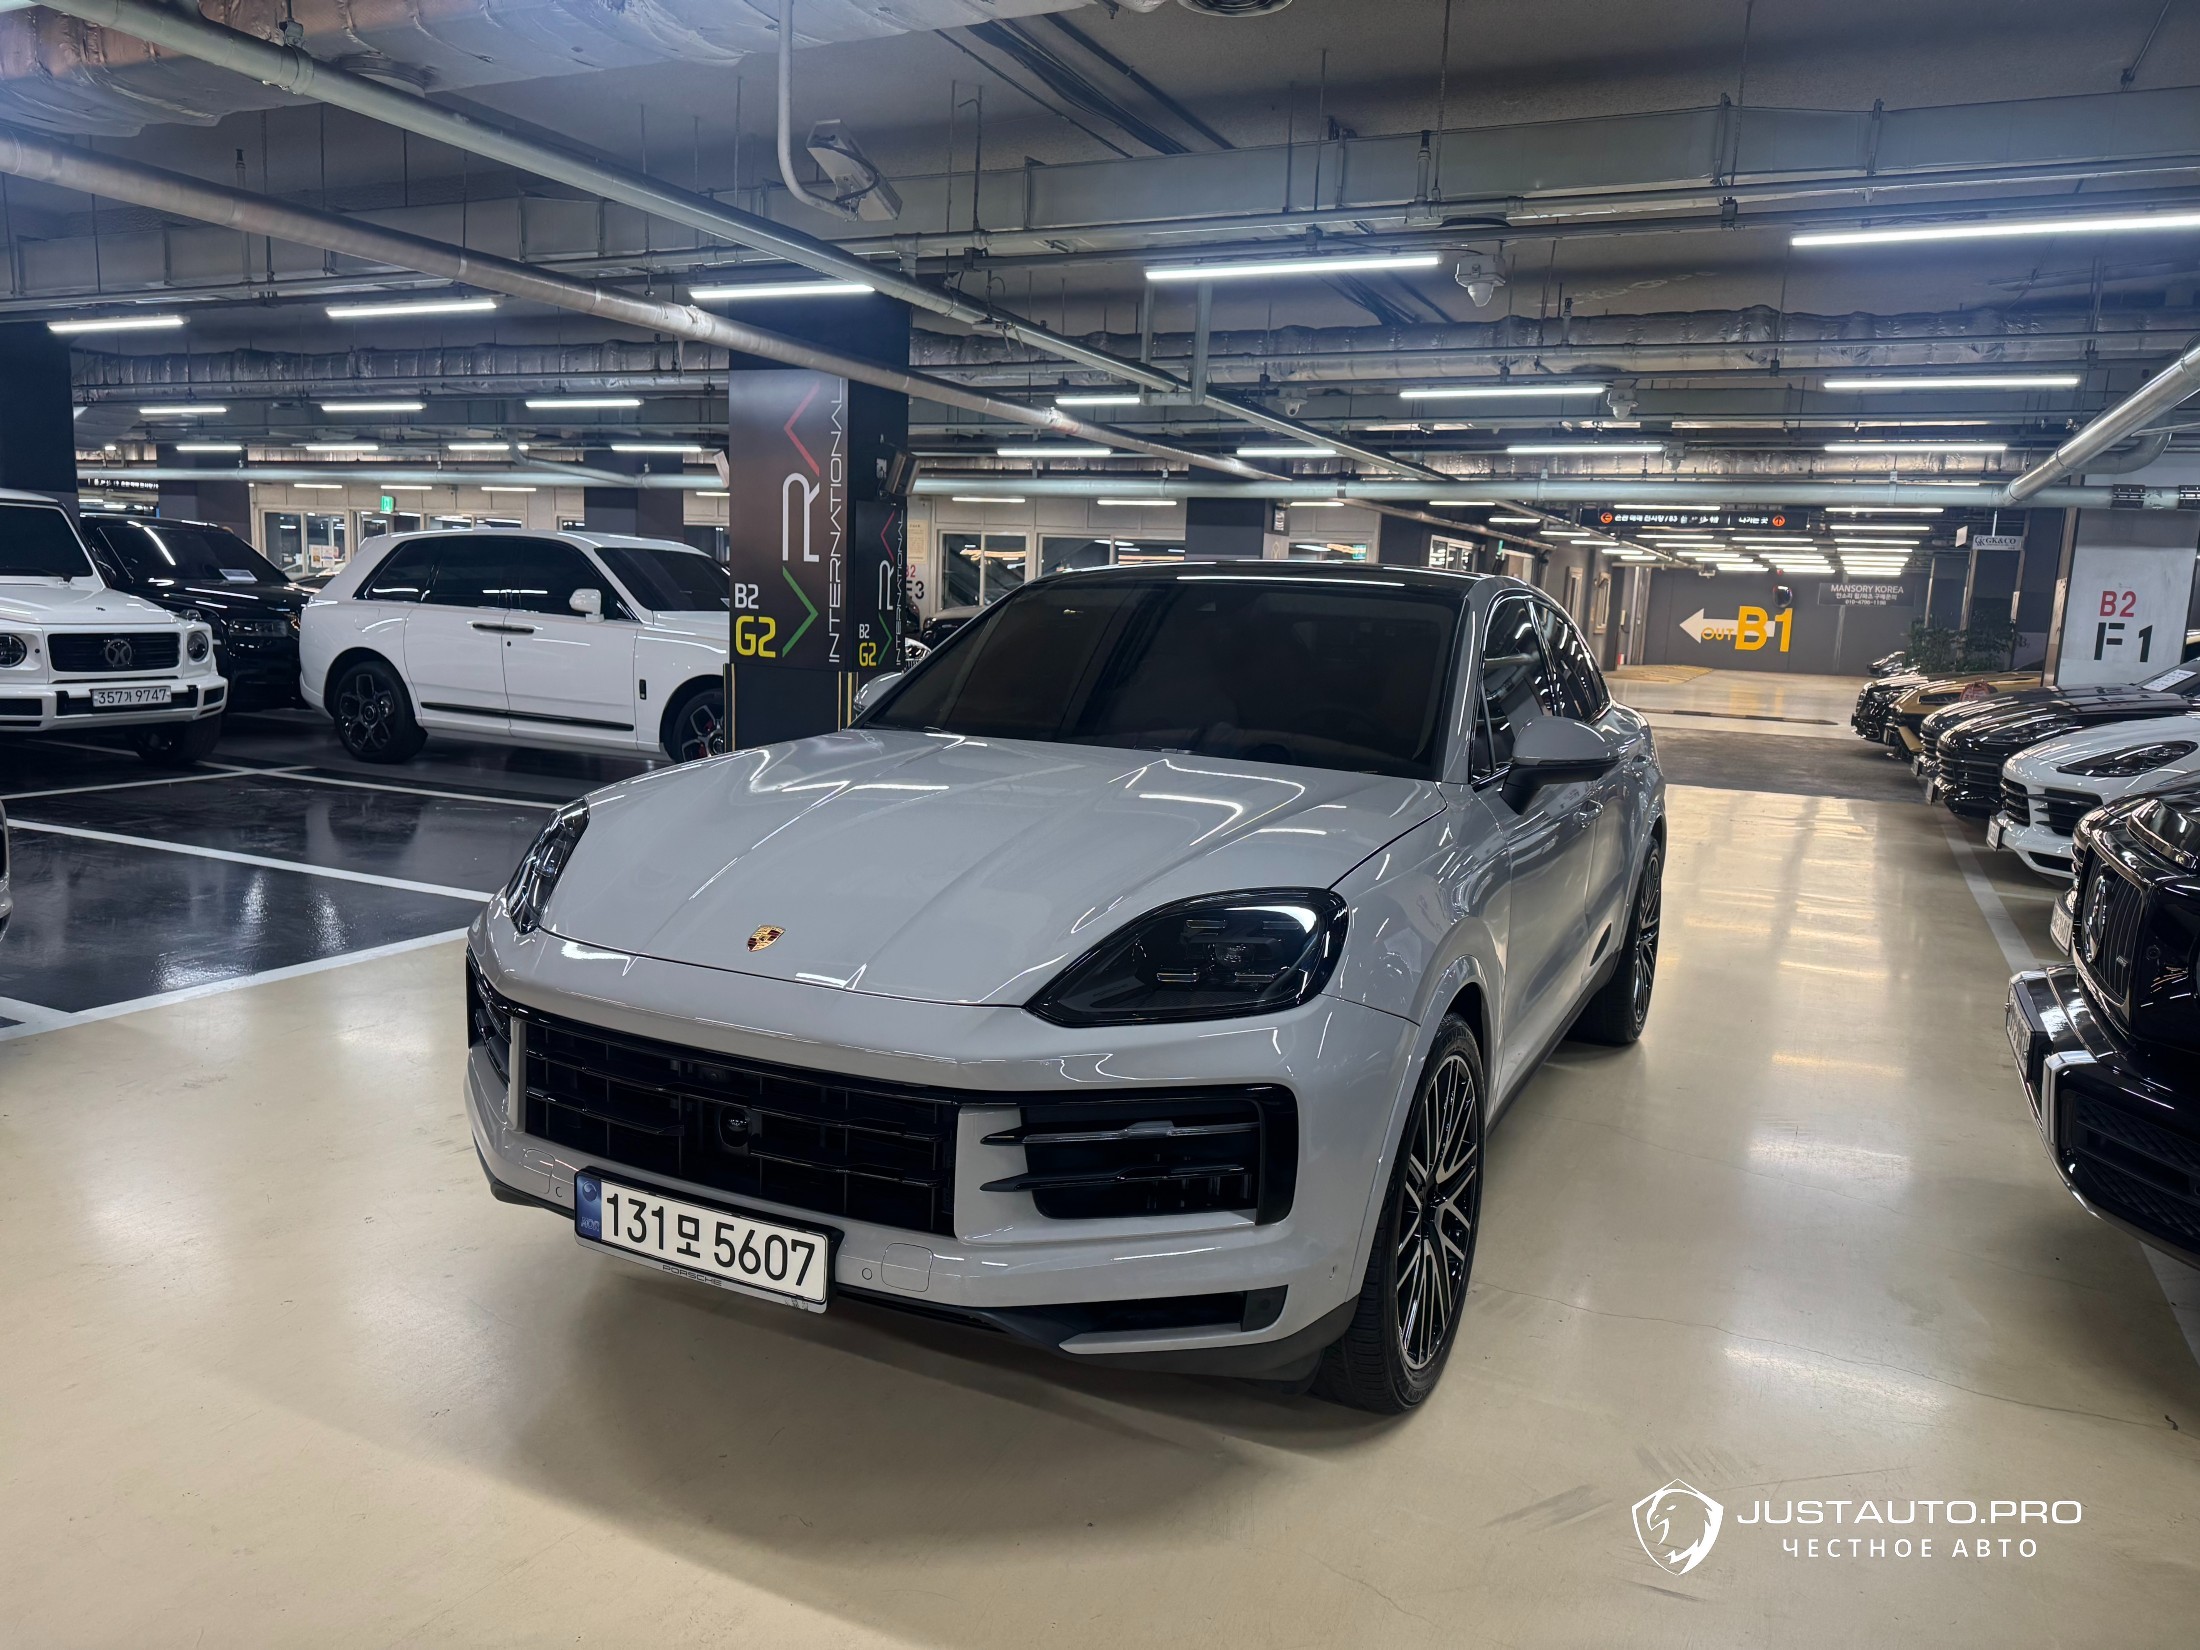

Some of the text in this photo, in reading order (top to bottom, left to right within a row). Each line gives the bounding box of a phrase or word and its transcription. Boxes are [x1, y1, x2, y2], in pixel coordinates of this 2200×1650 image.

[828, 376, 843, 664] INTERNATIONAL
[1985, 537, 2017, 545] GK&CO
[734, 581, 760, 610] B2
[1831, 584, 1904, 594] MANSORY KOREA
[2099, 590, 2137, 618] B2
[735, 614, 777, 659] G2
[858, 622, 871, 640] B2
[1701, 605, 1794, 653] OUT B1
[2093, 622, 2153, 663] F1
[858, 641, 878, 667] G2
[135, 688, 167, 703] 9747
[713, 1220, 816, 1287] 5607
[662, 1264, 722, 1287] PORSCHE
